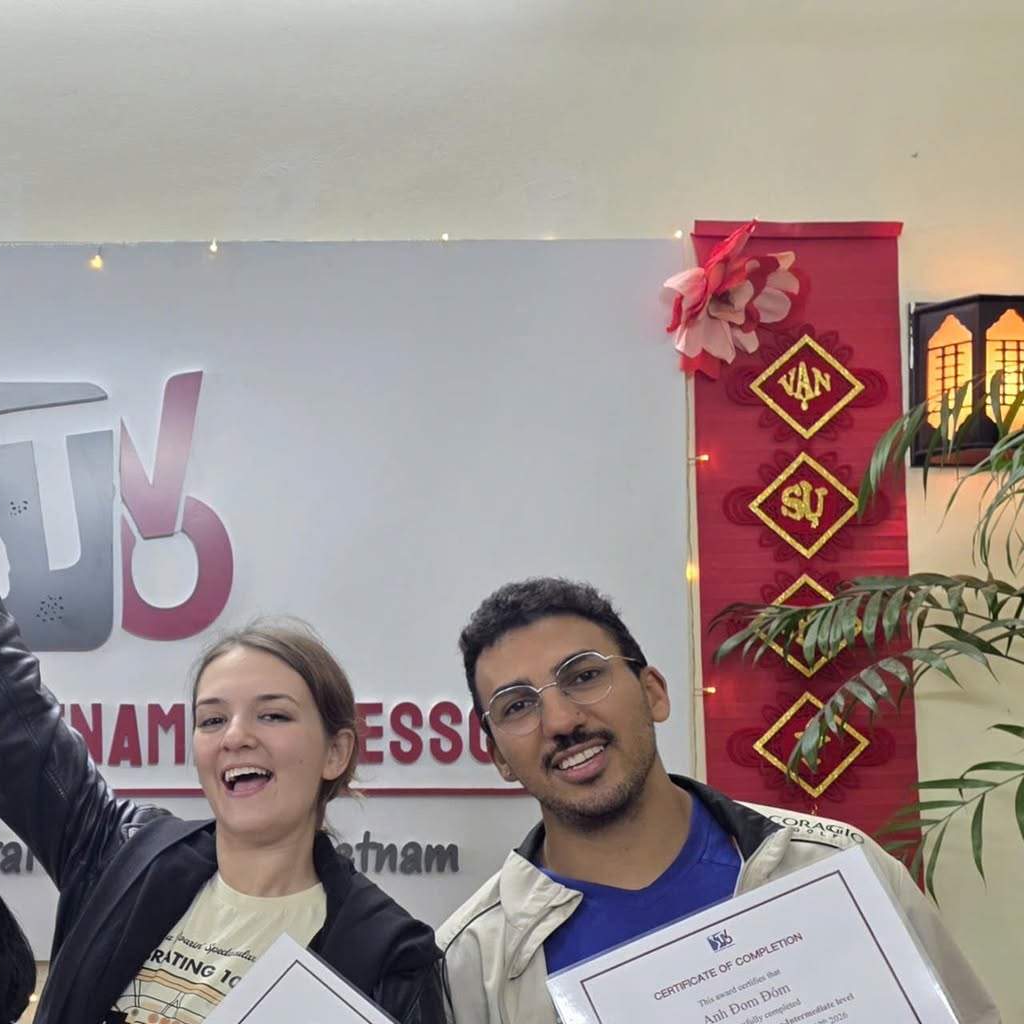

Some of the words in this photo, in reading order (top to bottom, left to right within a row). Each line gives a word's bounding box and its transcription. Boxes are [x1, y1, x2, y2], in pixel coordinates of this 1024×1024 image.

[777, 361, 832, 411] VẠN
[336, 831, 460, 874] etnam
[149, 949, 216, 978] RATING
[654, 968, 718, 1000] CERTIFICATE
[719, 961, 733, 973] OF
[735, 933, 803, 966] COMPLETION
[698, 997, 715, 1007] This
[715, 986, 737, 1000] award
[738, 975, 767, 991] certifies
[766, 969, 781, 978] that
[728, 997, 759, 1015] Đom
[760, 984, 791, 1002] Đóm
[835, 993, 854, 1005] level
[764, 998, 801, 1018] completed
[829, 1011, 848, 1024] 2026
